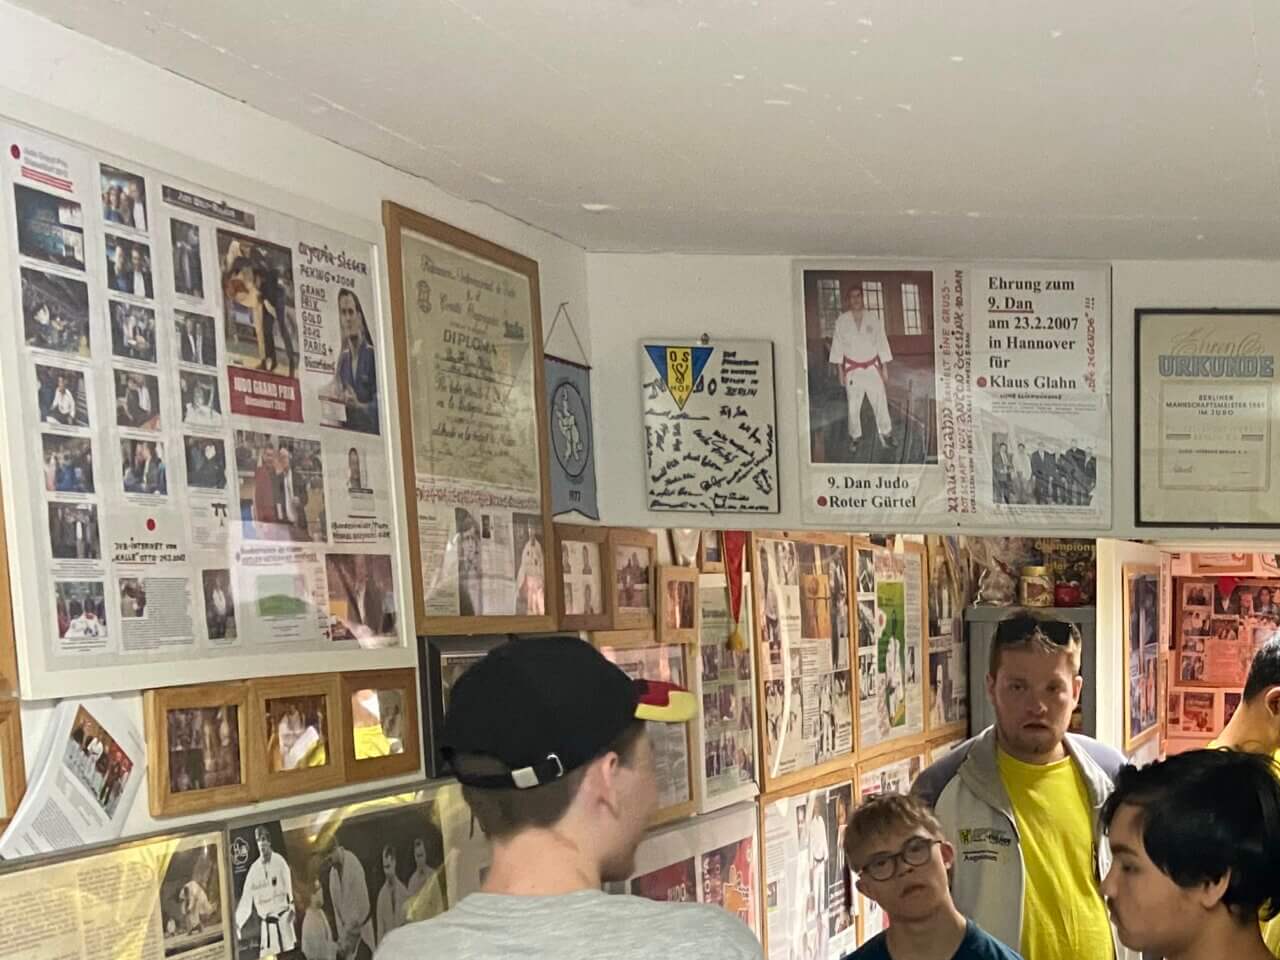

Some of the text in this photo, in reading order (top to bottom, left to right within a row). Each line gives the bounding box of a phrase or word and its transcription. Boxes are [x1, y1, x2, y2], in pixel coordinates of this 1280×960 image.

[300, 284, 326, 299] GRAND
[988, 277, 1075, 293] Ehrung zum
[988, 297, 1033, 310] 9. Dan
[302, 311, 322, 324] GOLD
[988, 317, 1079, 330] am 23.2.2007
[443, 329, 498, 355] DIPLOMA
[988, 336, 1076, 350] in Hannover
[988, 355, 1011, 369] für
[1158, 355, 1274, 378] URKUNDE
[989, 375, 1077, 389] Klaus Glahn
[827, 476, 909, 489] 9. Dan Judo
[829, 495, 916, 508] Roter Gürtel
